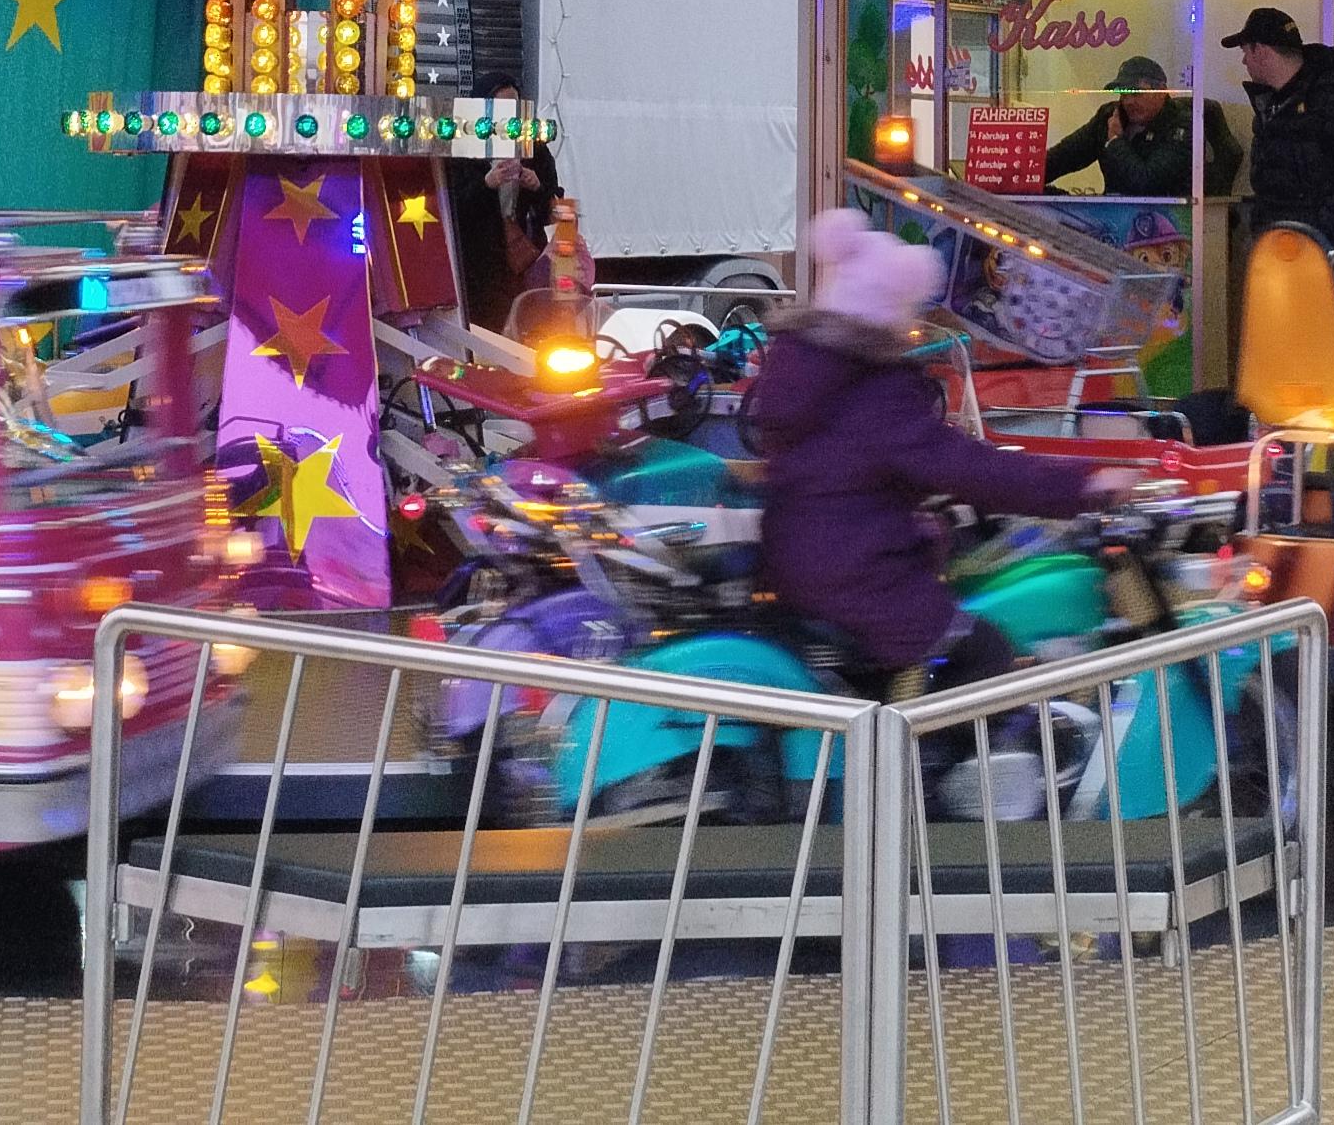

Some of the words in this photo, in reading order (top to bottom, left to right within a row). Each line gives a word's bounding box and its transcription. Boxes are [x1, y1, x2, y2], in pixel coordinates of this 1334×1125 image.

[972, 108, 1046, 122] FAHRPREIS
[978, 131, 1010, 142] Fahrchips
[1015, 131, 1024, 140] €
[976, 145, 1009, 156] Fahrchips
[1014, 145, 1023, 154] €
[975, 160, 1007, 170] Fahrchips
[1013, 159, 1021, 169] €
[974, 174, 1003, 185] Fahrchip
[1012, 175, 1020, 184] €
